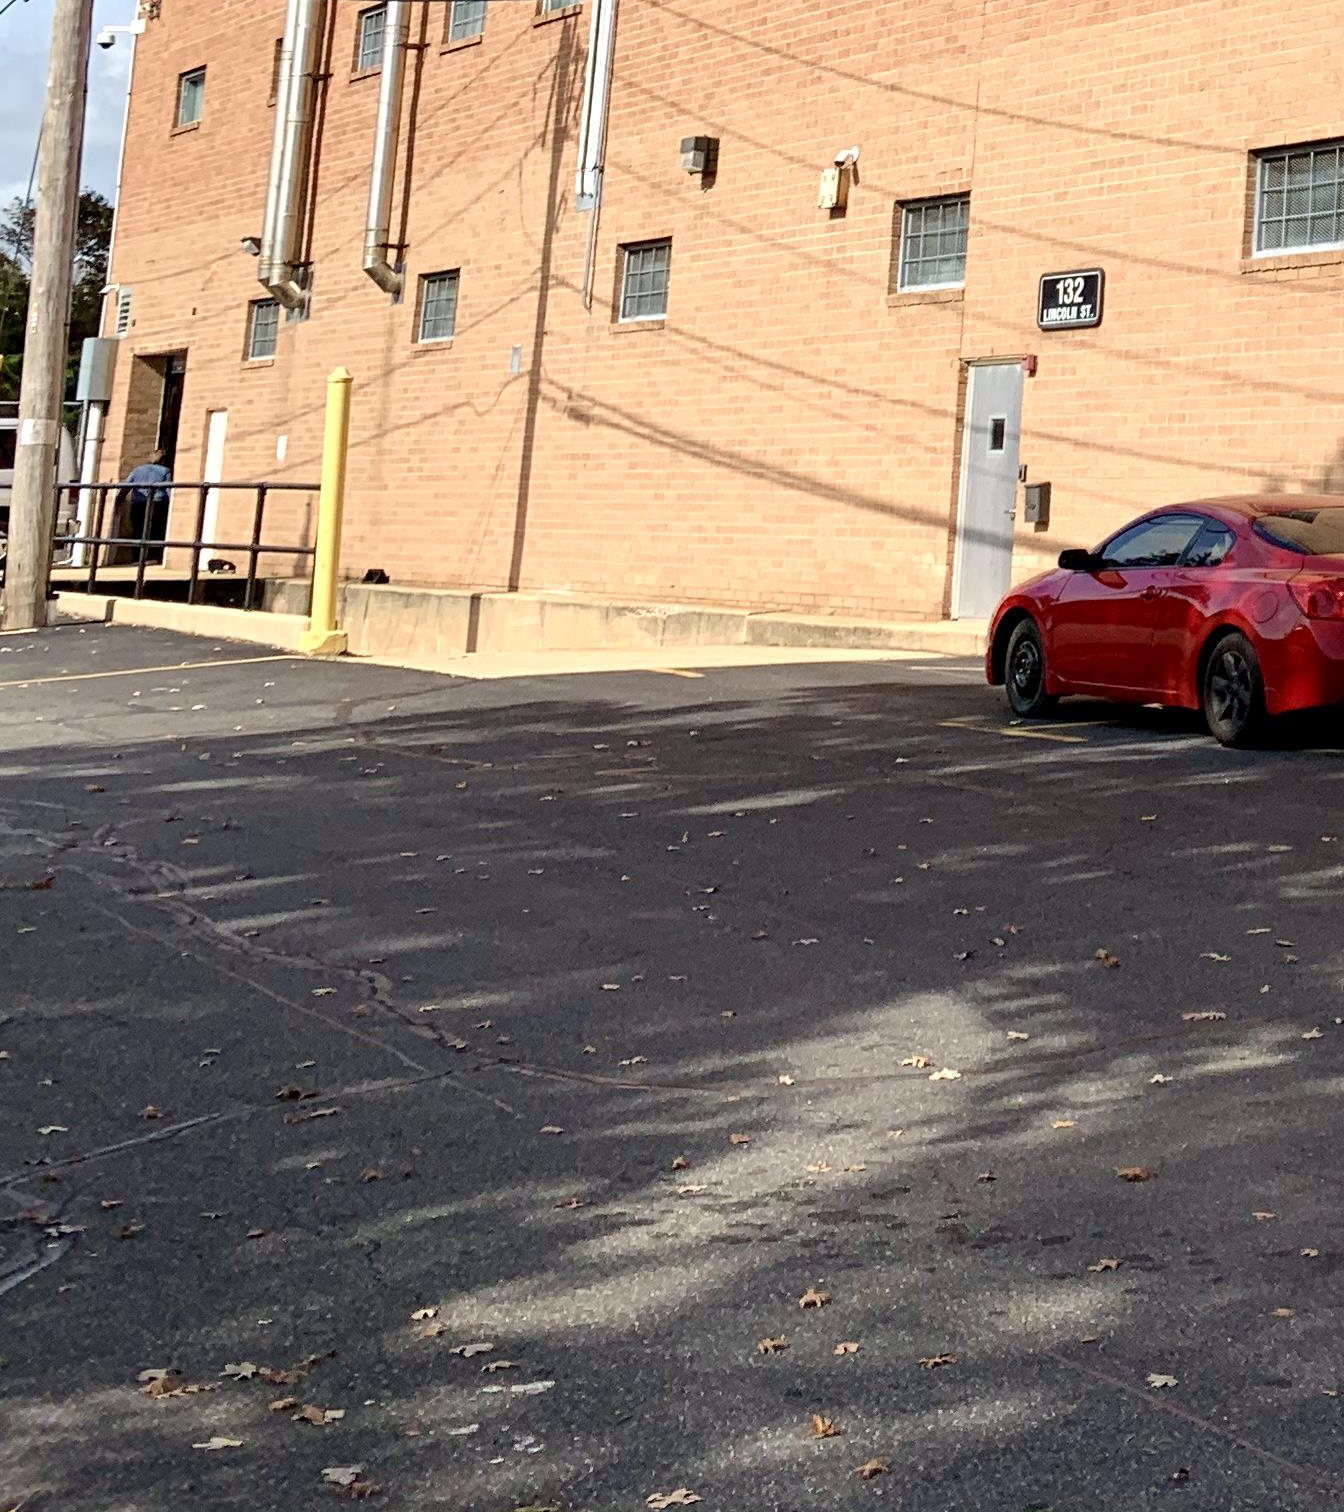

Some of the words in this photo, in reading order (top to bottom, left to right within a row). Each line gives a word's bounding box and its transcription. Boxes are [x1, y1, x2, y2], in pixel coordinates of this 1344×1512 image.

[1056, 277, 1085, 305] 132
[1043, 306, 1078, 322] LINCOLN
[1080, 304, 1095, 319] ST.
